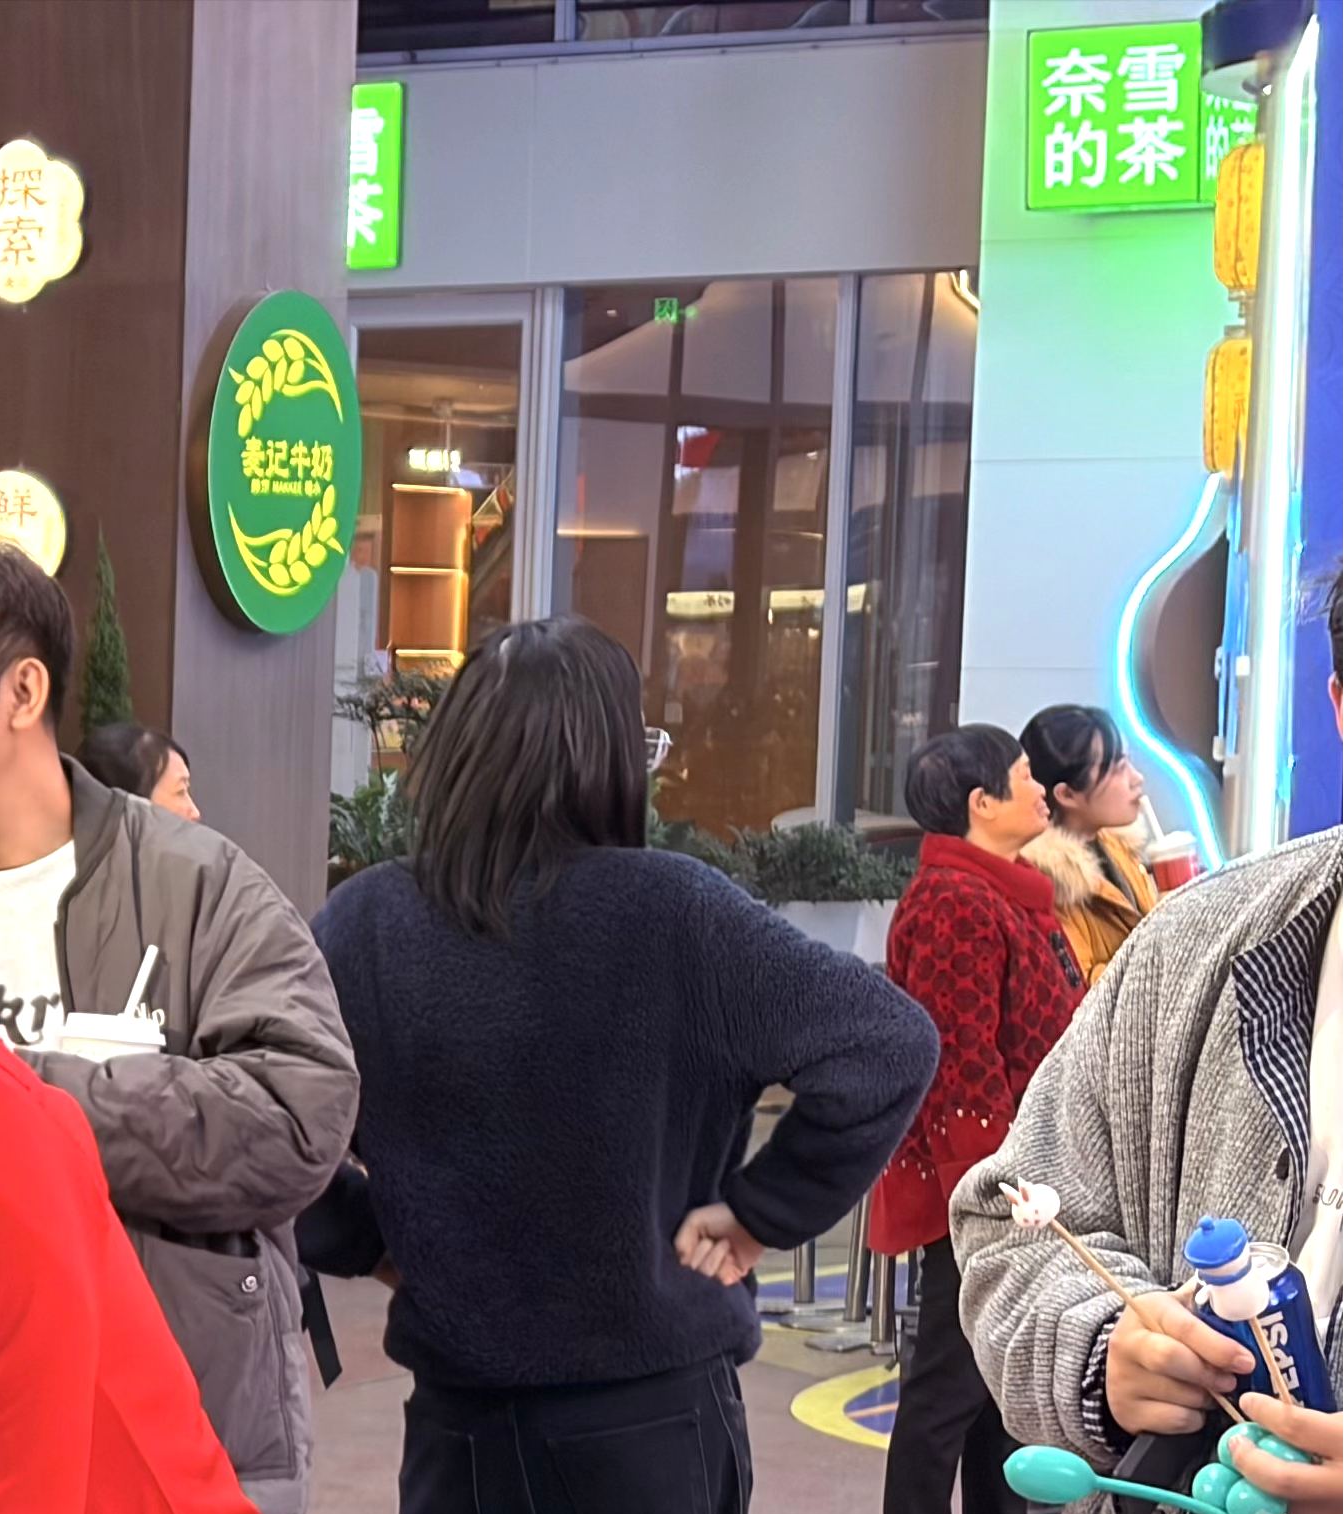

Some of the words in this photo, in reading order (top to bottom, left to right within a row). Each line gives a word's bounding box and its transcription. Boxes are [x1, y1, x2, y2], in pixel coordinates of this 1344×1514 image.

[1042, 43, 1186, 117] 奈雪
[1044, 115, 1186, 189] 的茶
[241, 435, 333, 481] 麦记牛奶
[1258, 1310, 1306, 1408] EPSI
